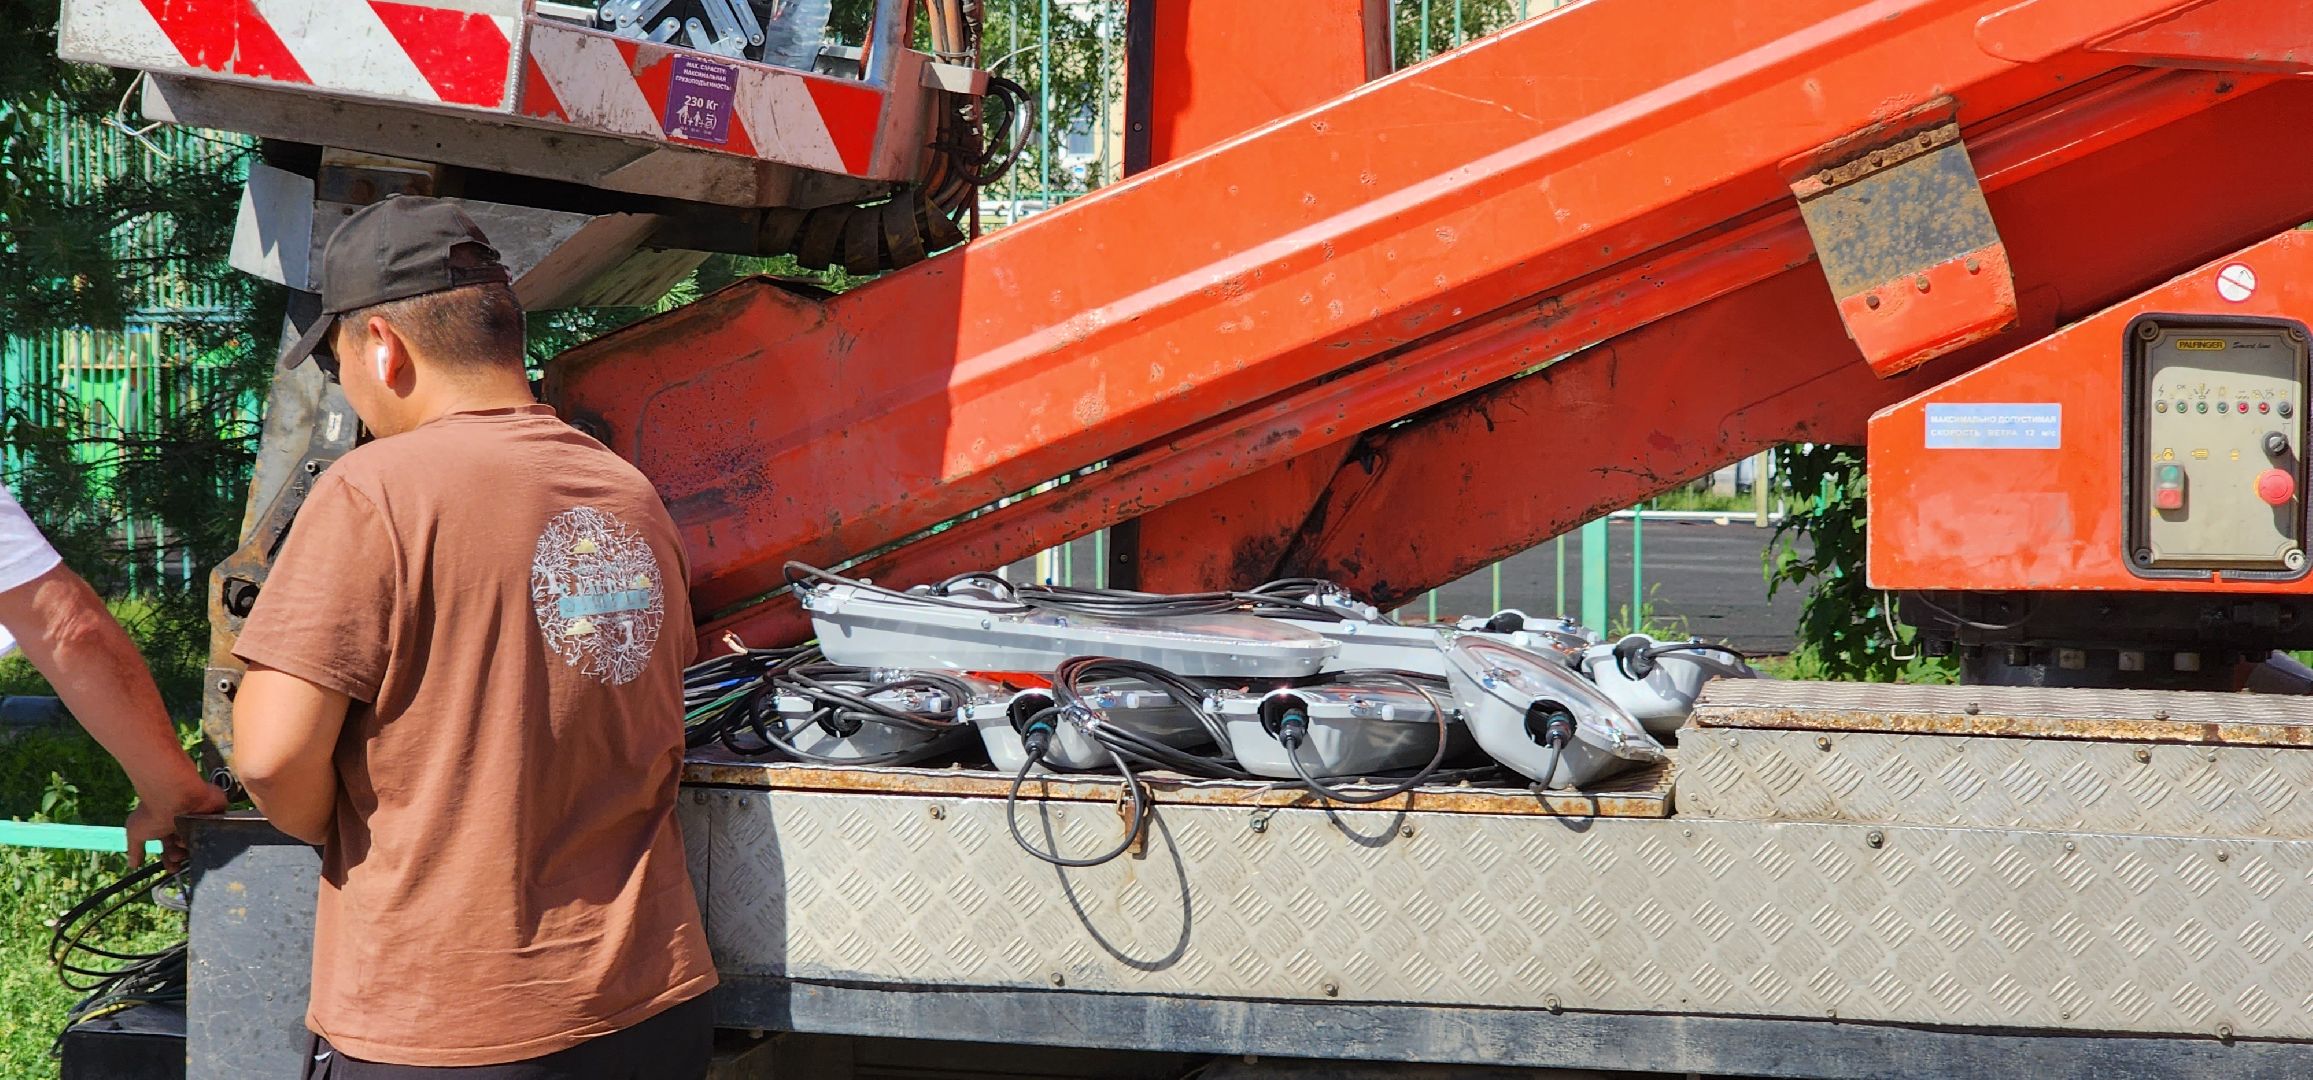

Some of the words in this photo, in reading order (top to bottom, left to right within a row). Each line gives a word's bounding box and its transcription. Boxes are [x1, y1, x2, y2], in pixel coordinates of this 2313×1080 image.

[683, 69, 727, 82] МАКСИМАЛЬНАЯ
[684, 95, 704, 108] 230
[2179, 341, 2223, 349] PALFINGER
[1930, 415, 1996, 424] МАКСИМАЛЬНО
[1998, 415, 2057, 425] ДОПУСТИМАЯ
[1930, 429, 1981, 438] СКОРОСТЬ
[1987, 429, 2017, 438] ВЕТРА
